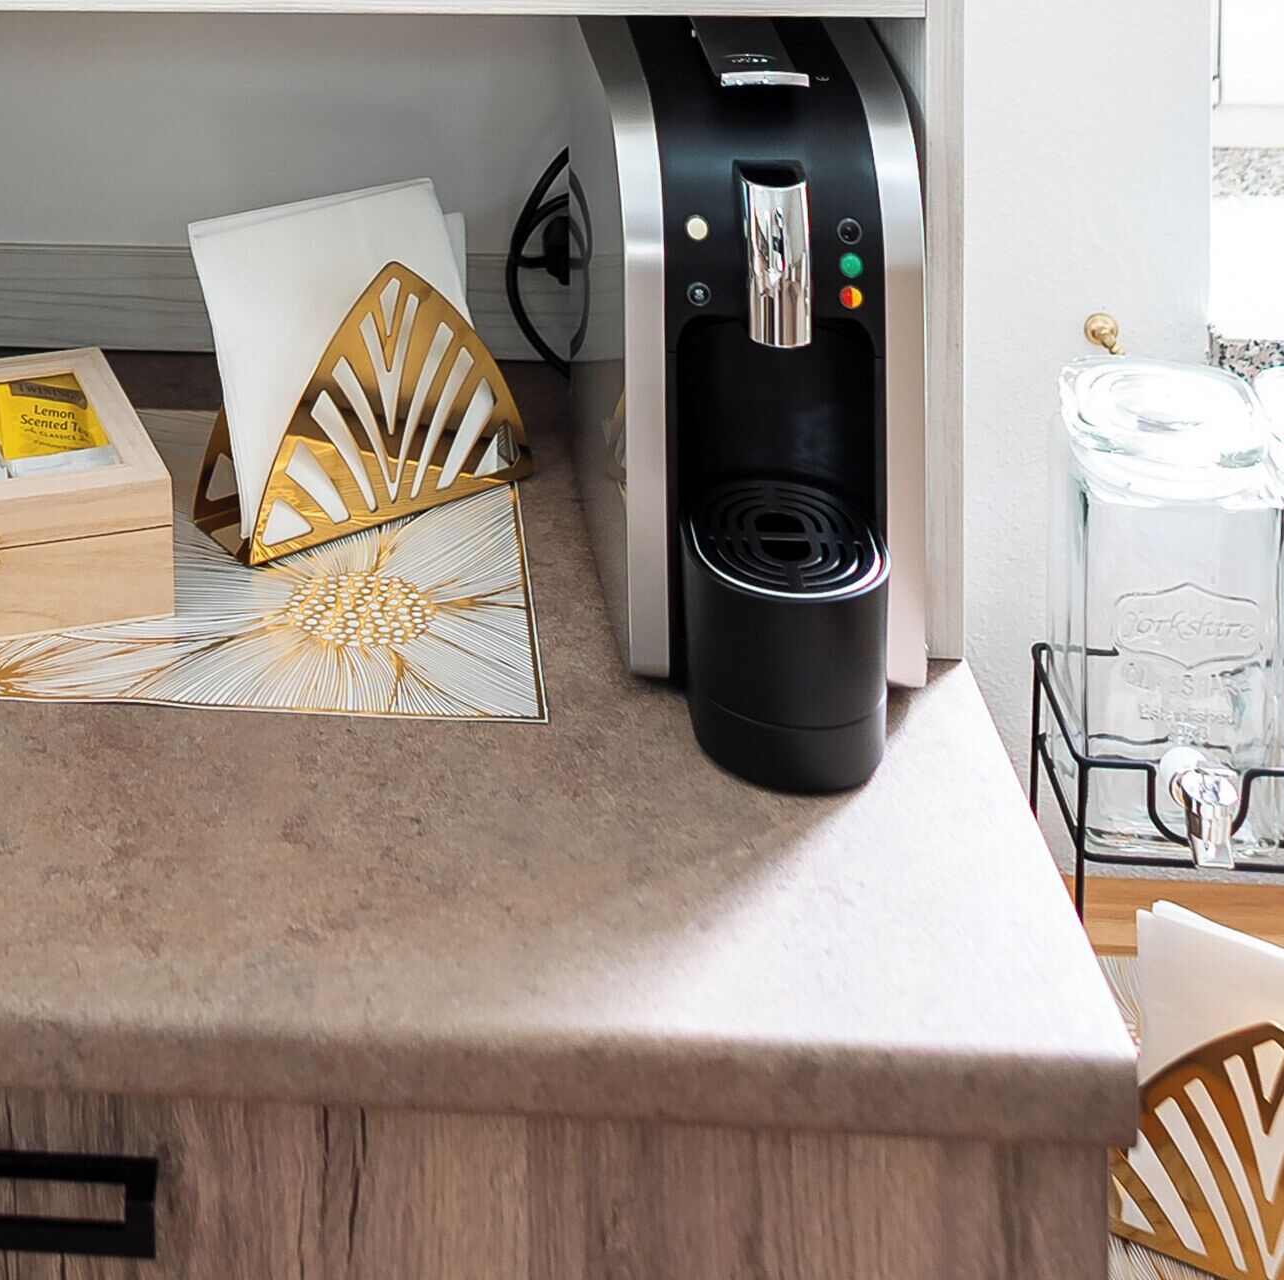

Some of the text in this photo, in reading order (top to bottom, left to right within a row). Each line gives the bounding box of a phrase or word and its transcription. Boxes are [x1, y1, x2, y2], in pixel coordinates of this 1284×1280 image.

[34, 404, 75, 419] Lemon
[20, 414, 68, 431] Scented
[38, 430, 77, 441] CLASSICS
[1121, 610, 1256, 641] Yorkshire
[1121, 659, 1253, 698] GLSSARE
